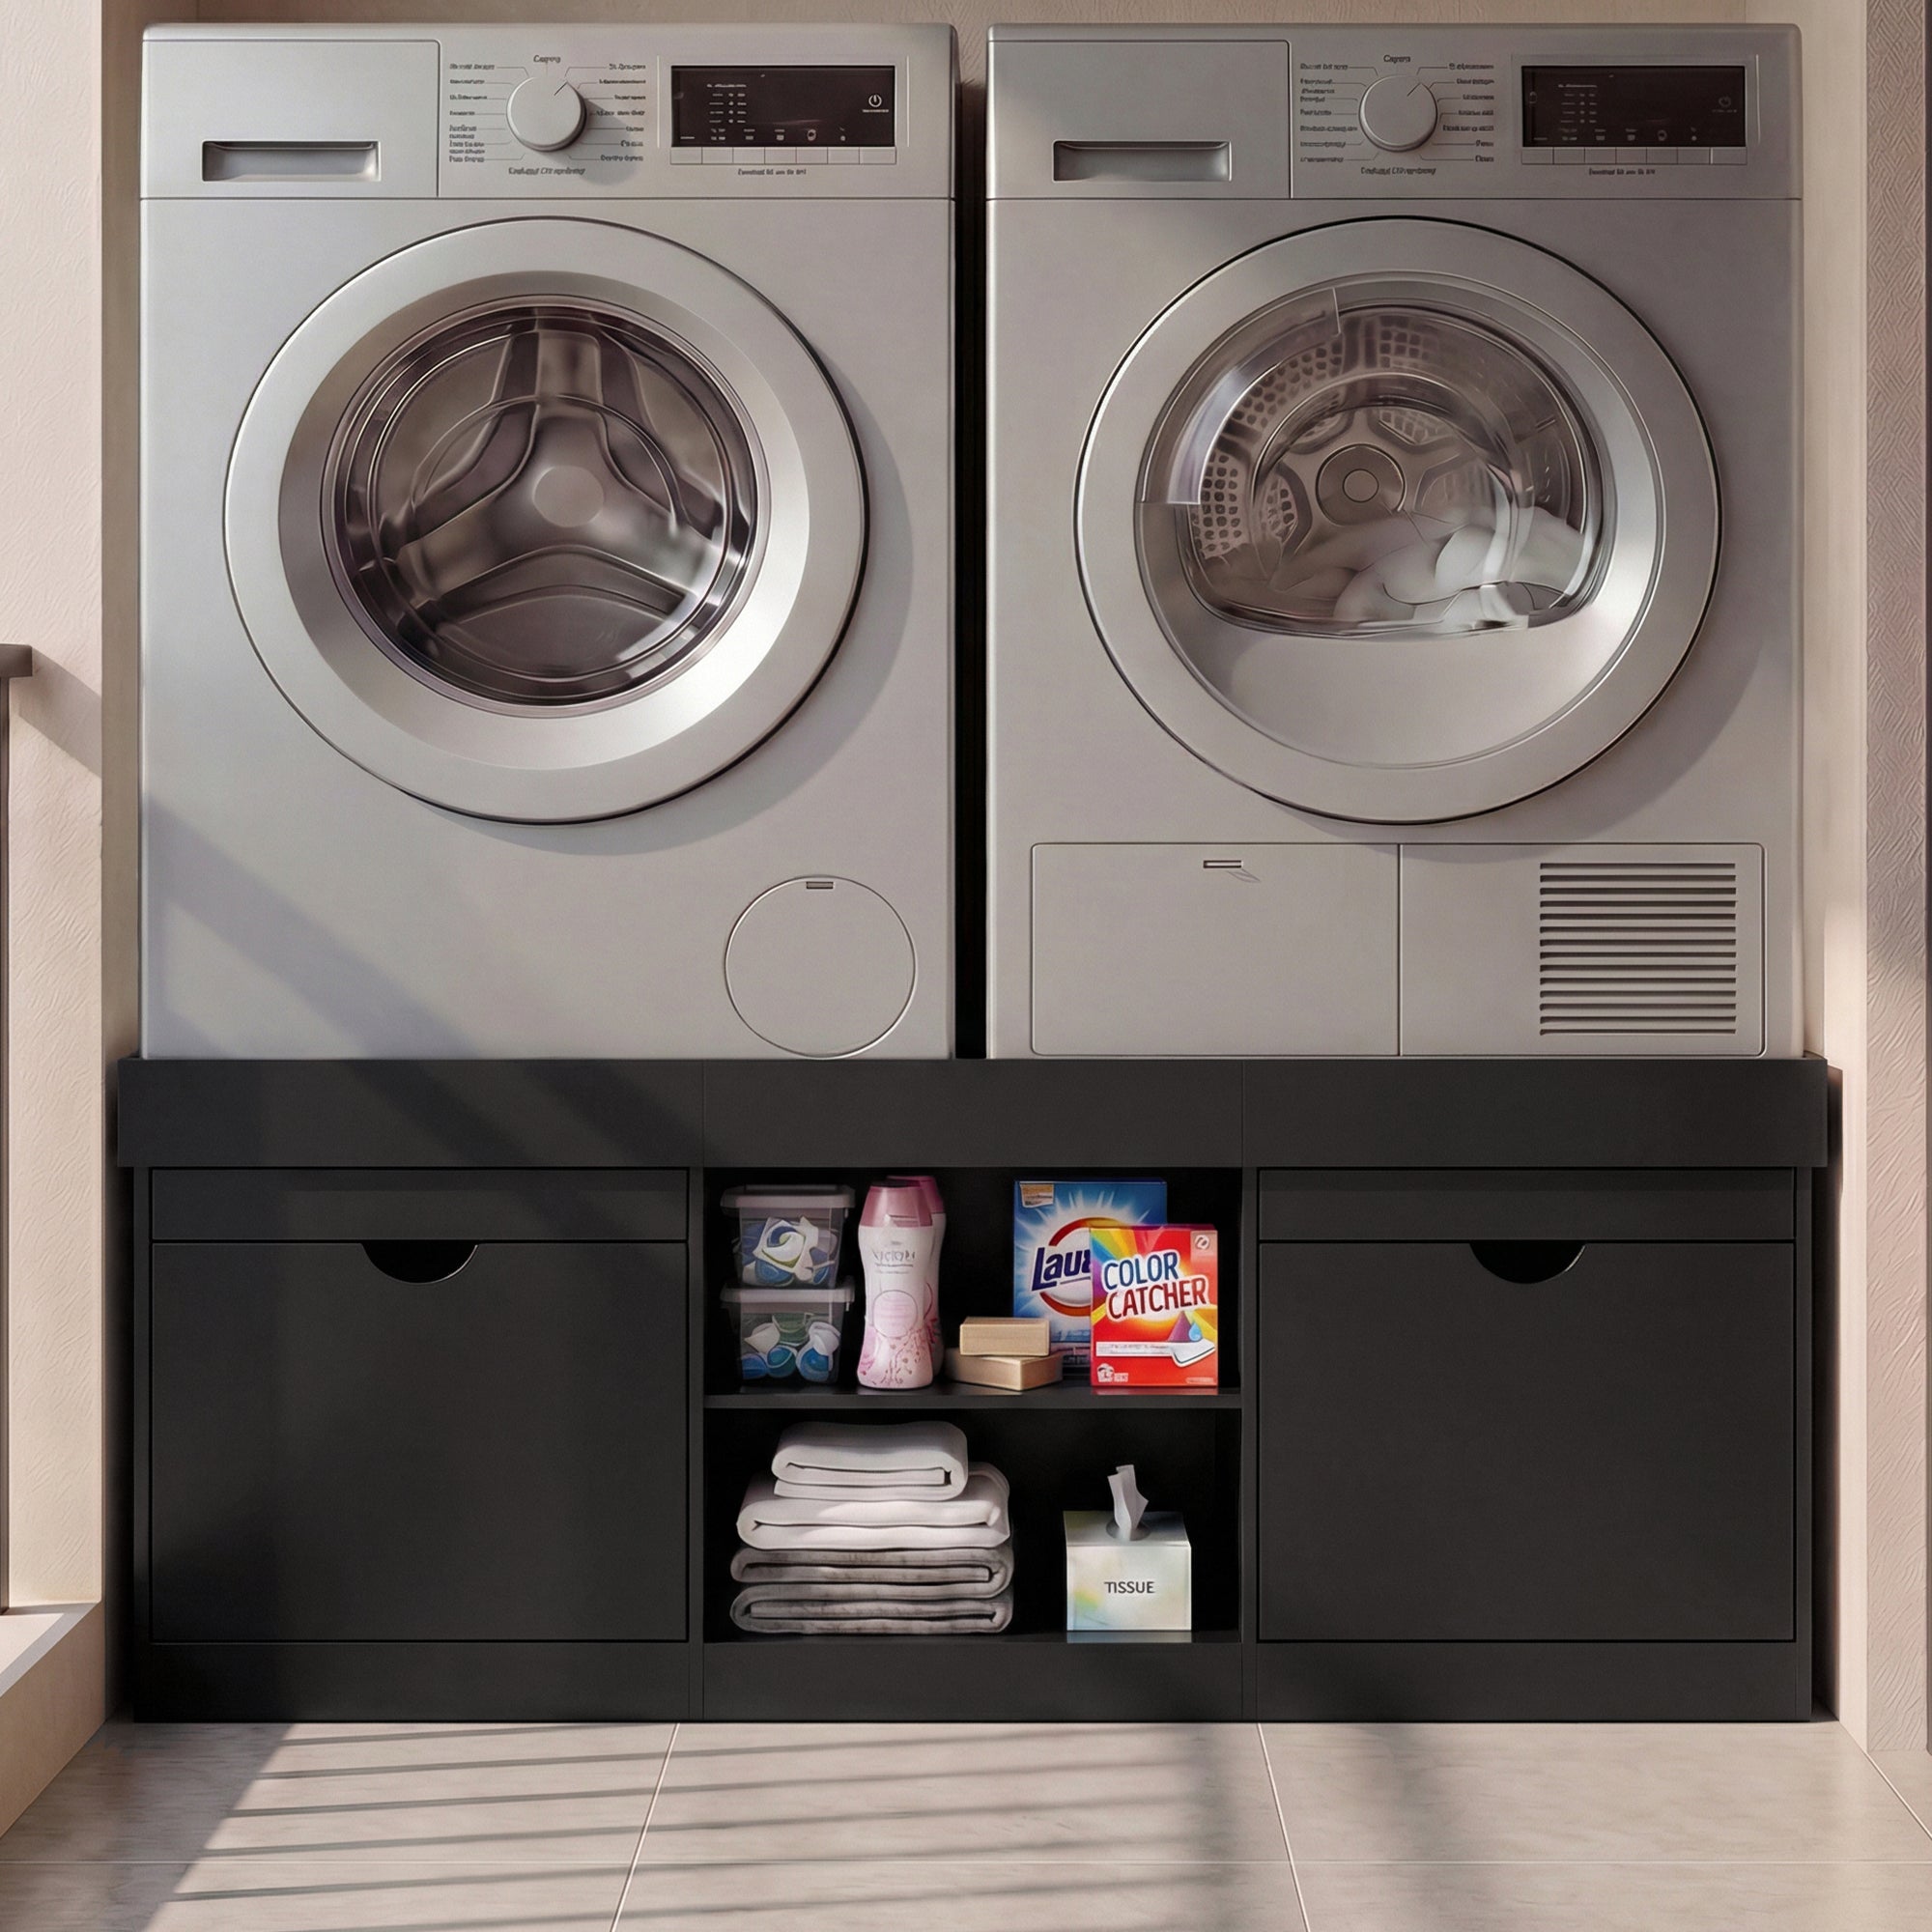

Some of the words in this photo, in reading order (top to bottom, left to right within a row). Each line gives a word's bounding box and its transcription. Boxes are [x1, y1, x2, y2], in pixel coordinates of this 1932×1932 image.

[1104, 1252, 1179, 1291] COLOR
[1108, 1278, 1208, 1320] CATCHER
[1104, 1580, 1155, 1594] TISSUE
